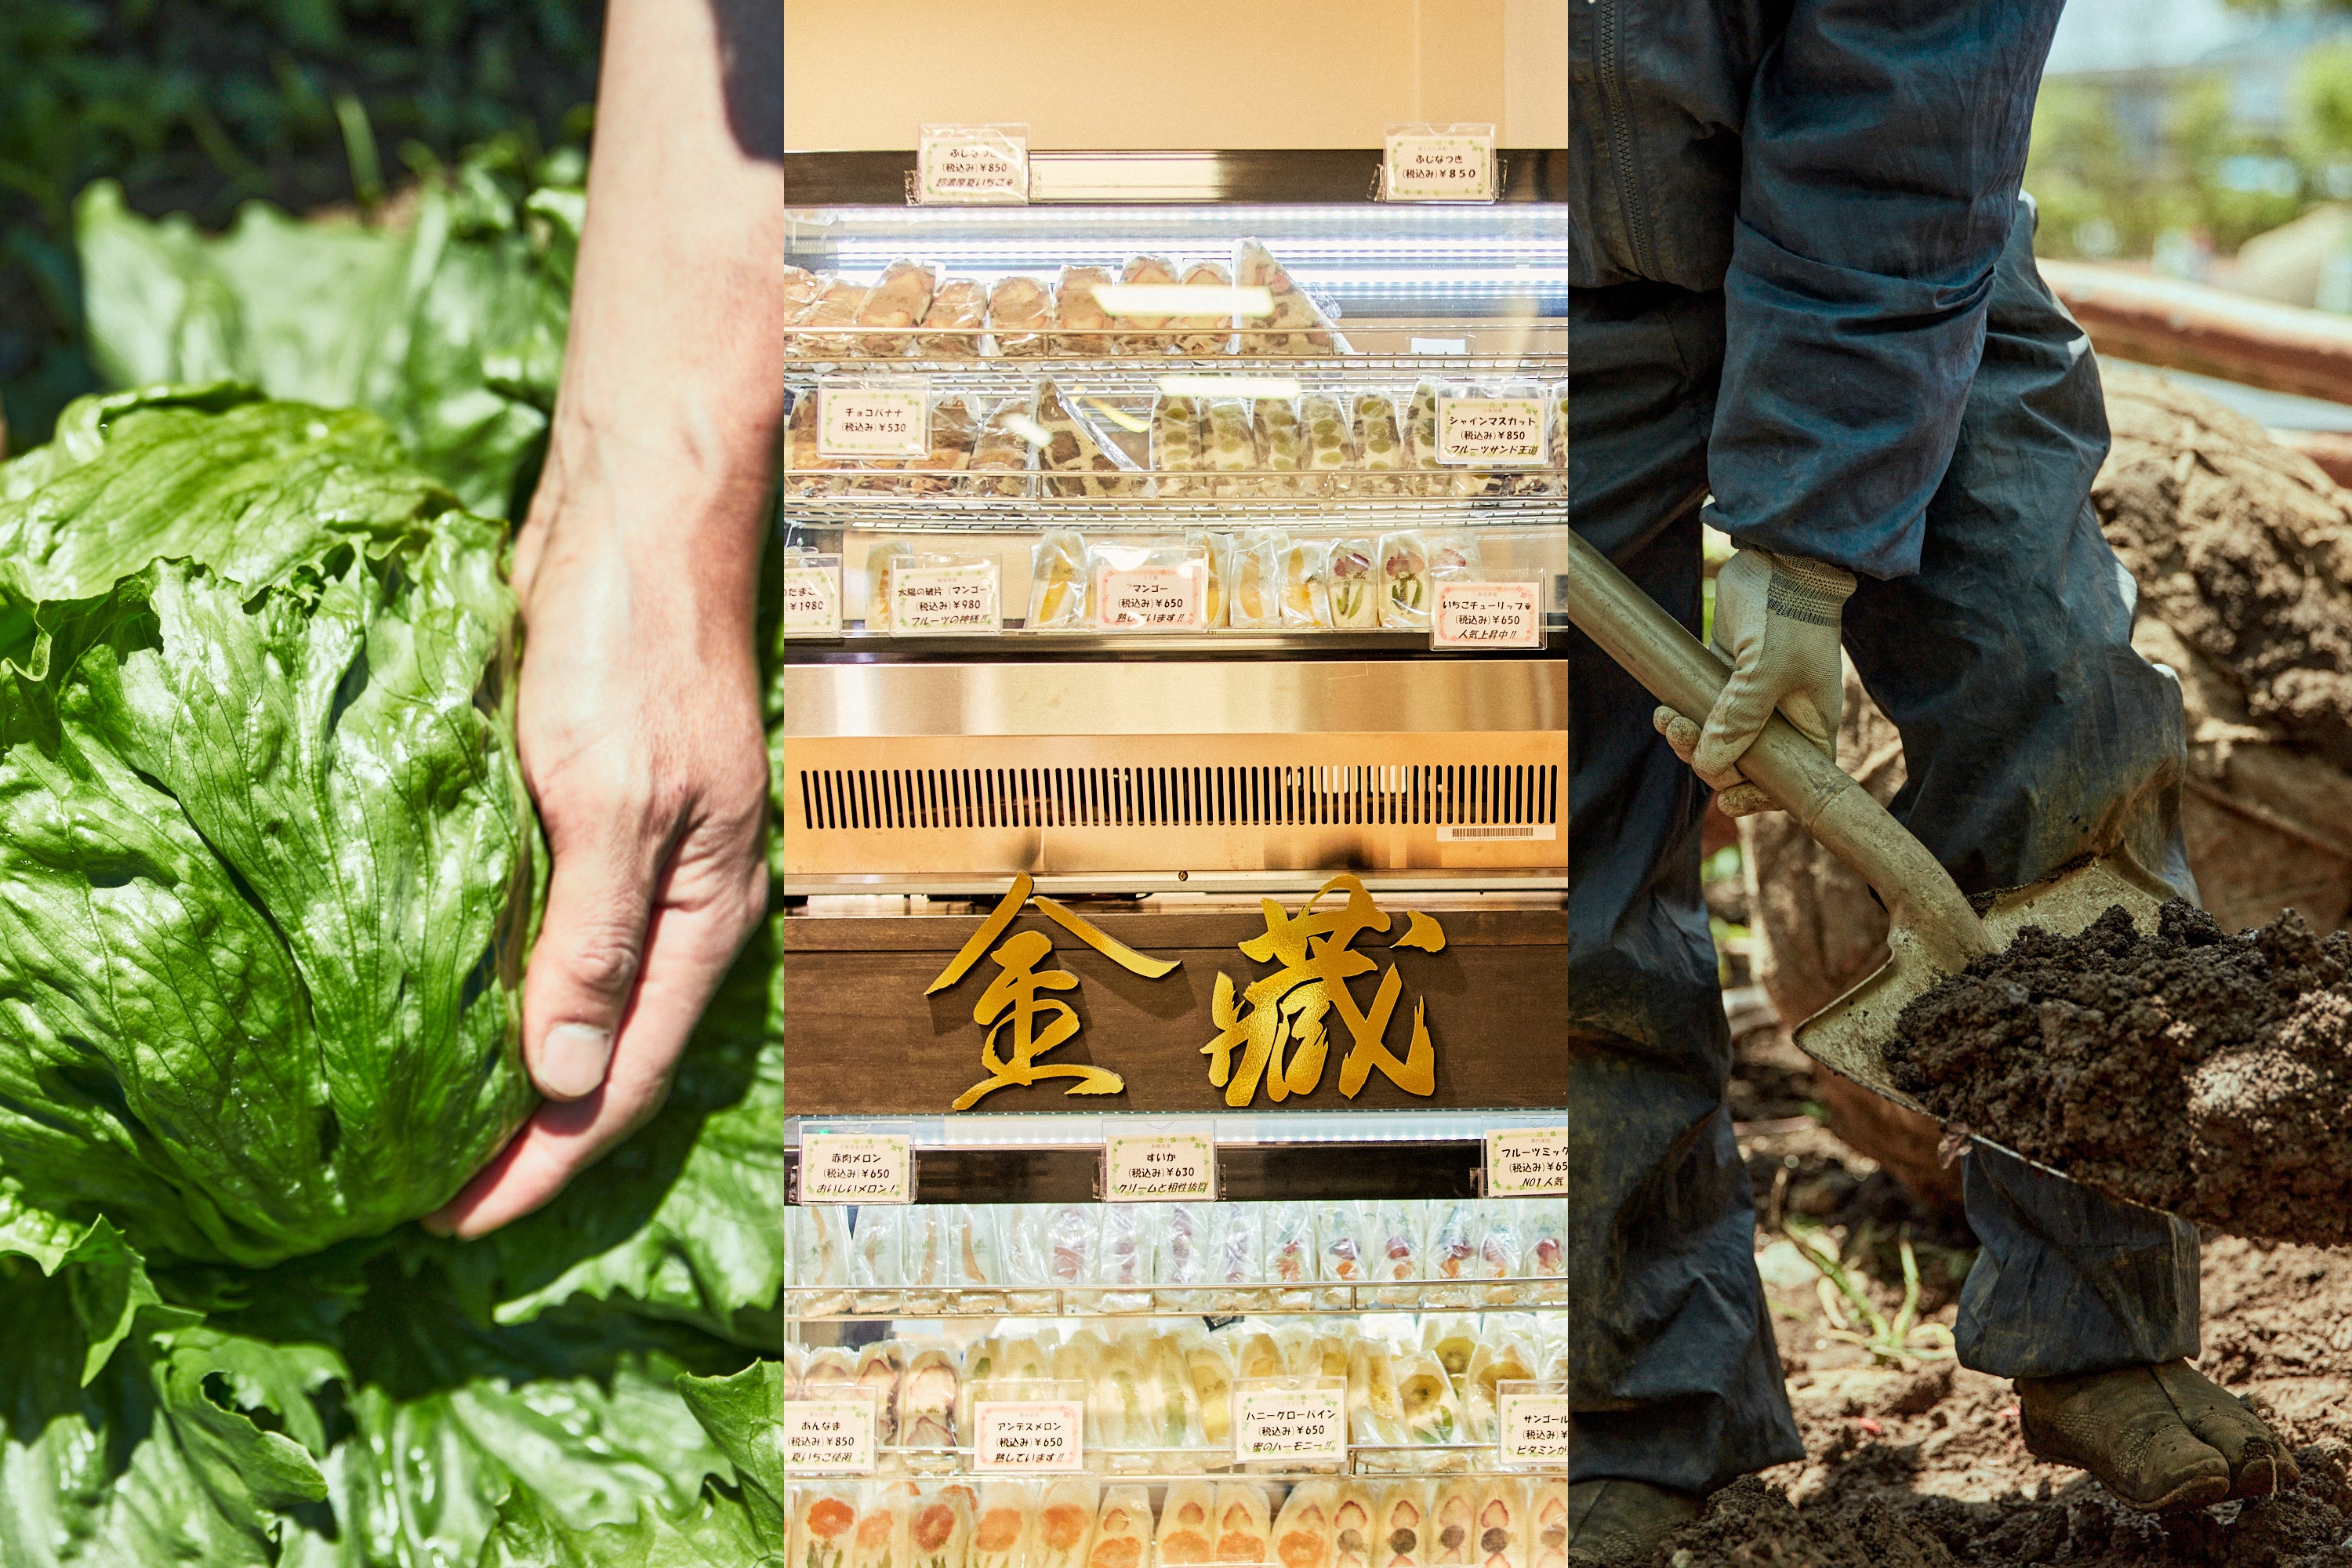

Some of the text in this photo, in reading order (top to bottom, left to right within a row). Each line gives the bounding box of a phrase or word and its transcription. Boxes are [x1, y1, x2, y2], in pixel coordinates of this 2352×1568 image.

[1416, 155, 1463, 164] ふじなつき
[942, 163, 1007, 173] (税込み)¥850
[1403, 169, 1475, 179] (税込み)¥850
[845, 408, 902, 417] チョコバナナ
[1450, 417, 1536, 426] シャインマスカット
[841, 423, 906, 433] (税込み)¥530
[1461, 430, 1525, 441] (税込み)¥850
[1450, 445, 1538, 456] フルーツサンド王道
[1133, 584, 1168, 593] マンゴー
[916, 600, 980, 612] (税込み)¥980
[1118, 598, 1183, 608] (税込み)¥650
[1443, 601, 1523, 610] いちごチューリップ
[912, 615, 988, 626] フルーツの神様!!
[1455, 615, 1520, 625] (税込み)¥650
[1458, 630, 1517, 640] 人気上昇中!!
[832, 1153, 881, 1163] 赤肉メロン
[1147, 1153, 1176, 1162] すいか
[1509, 1161, 1568, 1173] (税込み)¥65
[823, 1168, 890, 1179] (税込み)¥650
[1128, 1167, 1194, 1178] (税込み)¥630
[817, 1184, 895, 1193] おいしいメロン!
[1119, 1181, 1209, 1193] クリームと相性抜群
[1524, 1415, 1568, 1424] サンゴール
[998, 1422, 1061, 1431] アンデスメロン
[1258, 1425, 1324, 1436] (税込み)¥650
[787, 1436, 855, 1447] (税込み)¥850
[996, 1437, 1062, 1447] (税込み)¥650
[1253, 1441, 1332, 1452] 蜜のハーモニー!!
[1517, 1446, 1568, 1455] ビタミンが
[791, 1452, 852, 1462] 夏いちご使用
[994, 1453, 1064, 1463] 熟しています!!
